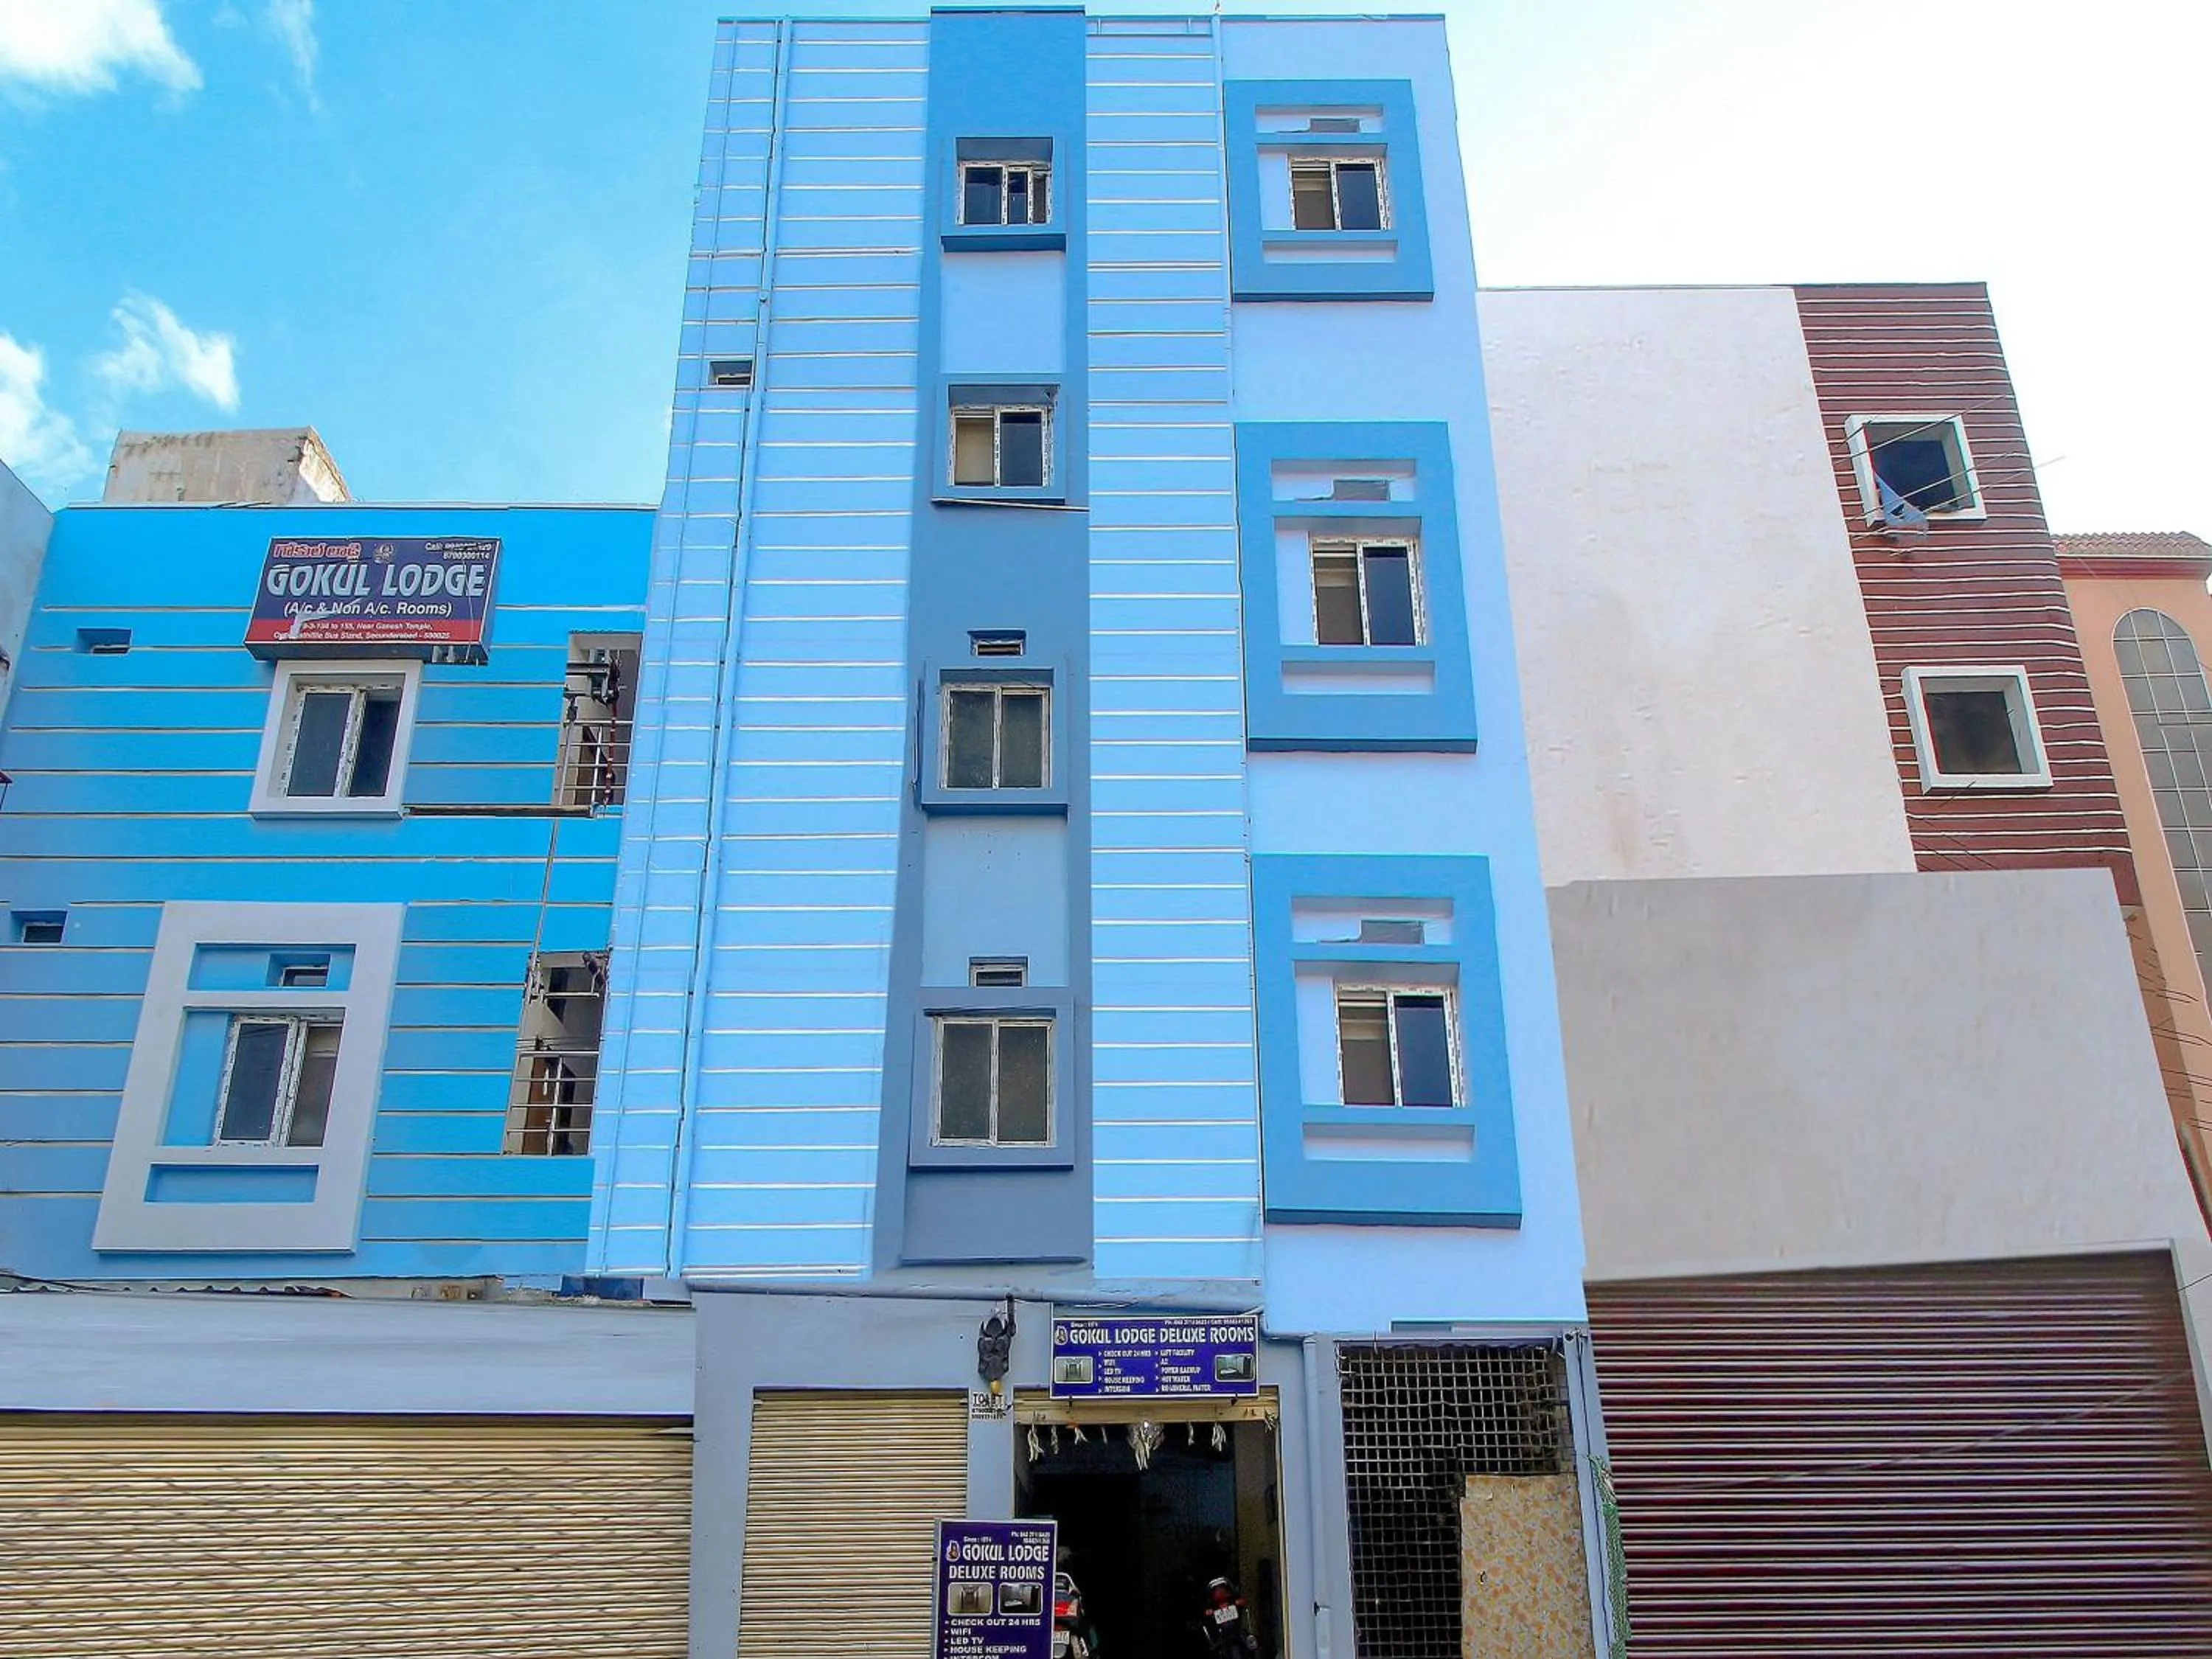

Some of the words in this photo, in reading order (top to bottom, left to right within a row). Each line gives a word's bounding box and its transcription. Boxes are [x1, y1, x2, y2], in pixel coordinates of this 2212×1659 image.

[267, 565, 371, 597] GOKUL
[381, 564, 485, 597] LODGE
[317, 602, 328, 614] &
[332, 602, 360, 614] Non
[364, 602, 392, 616] A/c.
[397, 602, 452, 618] Rooms)
[1070, 1329, 1111, 1344] GOKUL
[1115, 1328, 1156, 1344] LODGE
[1161, 1328, 1206, 1343] DELUXE
[1210, 1327, 1254, 1343] ROOMS
[962, 1545, 1005, 1561] GOKUL
[1009, 1545, 1049, 1562] LODGE
[949, 1566, 995, 1579] DELUXE
[1000, 1565, 1045, 1579] ROOMS
[1021, 1618, 1040, 1626] HRS
[971, 1636, 984, 1644] TV
[950, 1646, 983, 1654] HOUSE
[985, 1645, 1027, 1653] KEEPING
